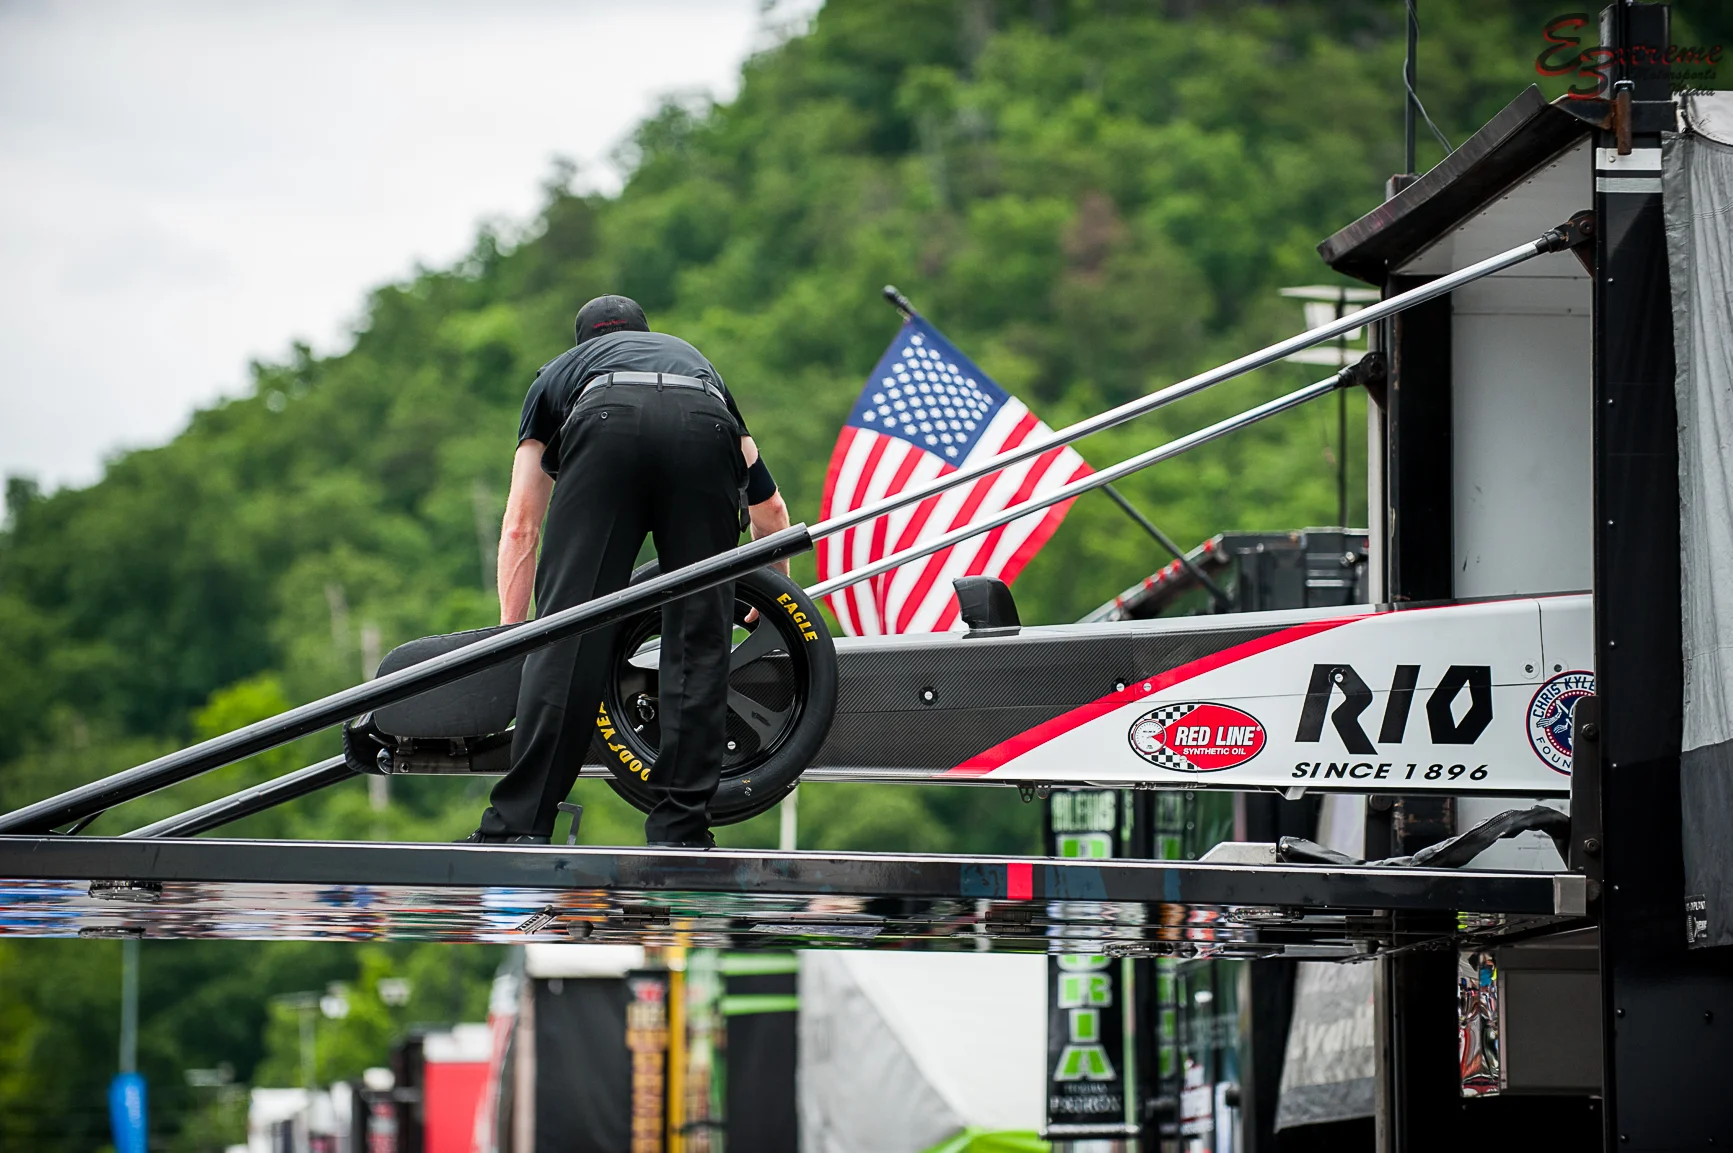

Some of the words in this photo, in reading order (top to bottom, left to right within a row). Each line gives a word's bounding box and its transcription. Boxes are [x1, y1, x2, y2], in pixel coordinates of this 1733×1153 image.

[776, 592, 818, 642] EAGLE
[1294, 663, 1494, 756] RIO
[1533, 683, 1561, 718] CHRIS
[1564, 675, 1595, 691] KYLE
[1174, 726, 1211, 746] RED
[1215, 726, 1256, 746] LINE
[1182, 747, 1230, 756] SYNTHETIC
[1231, 747, 1247, 756] OIL
[1536, 736, 1571, 768] FOUN
[1291, 762, 1393, 780] SINCE
[1396, 763, 1489, 781] 1896
